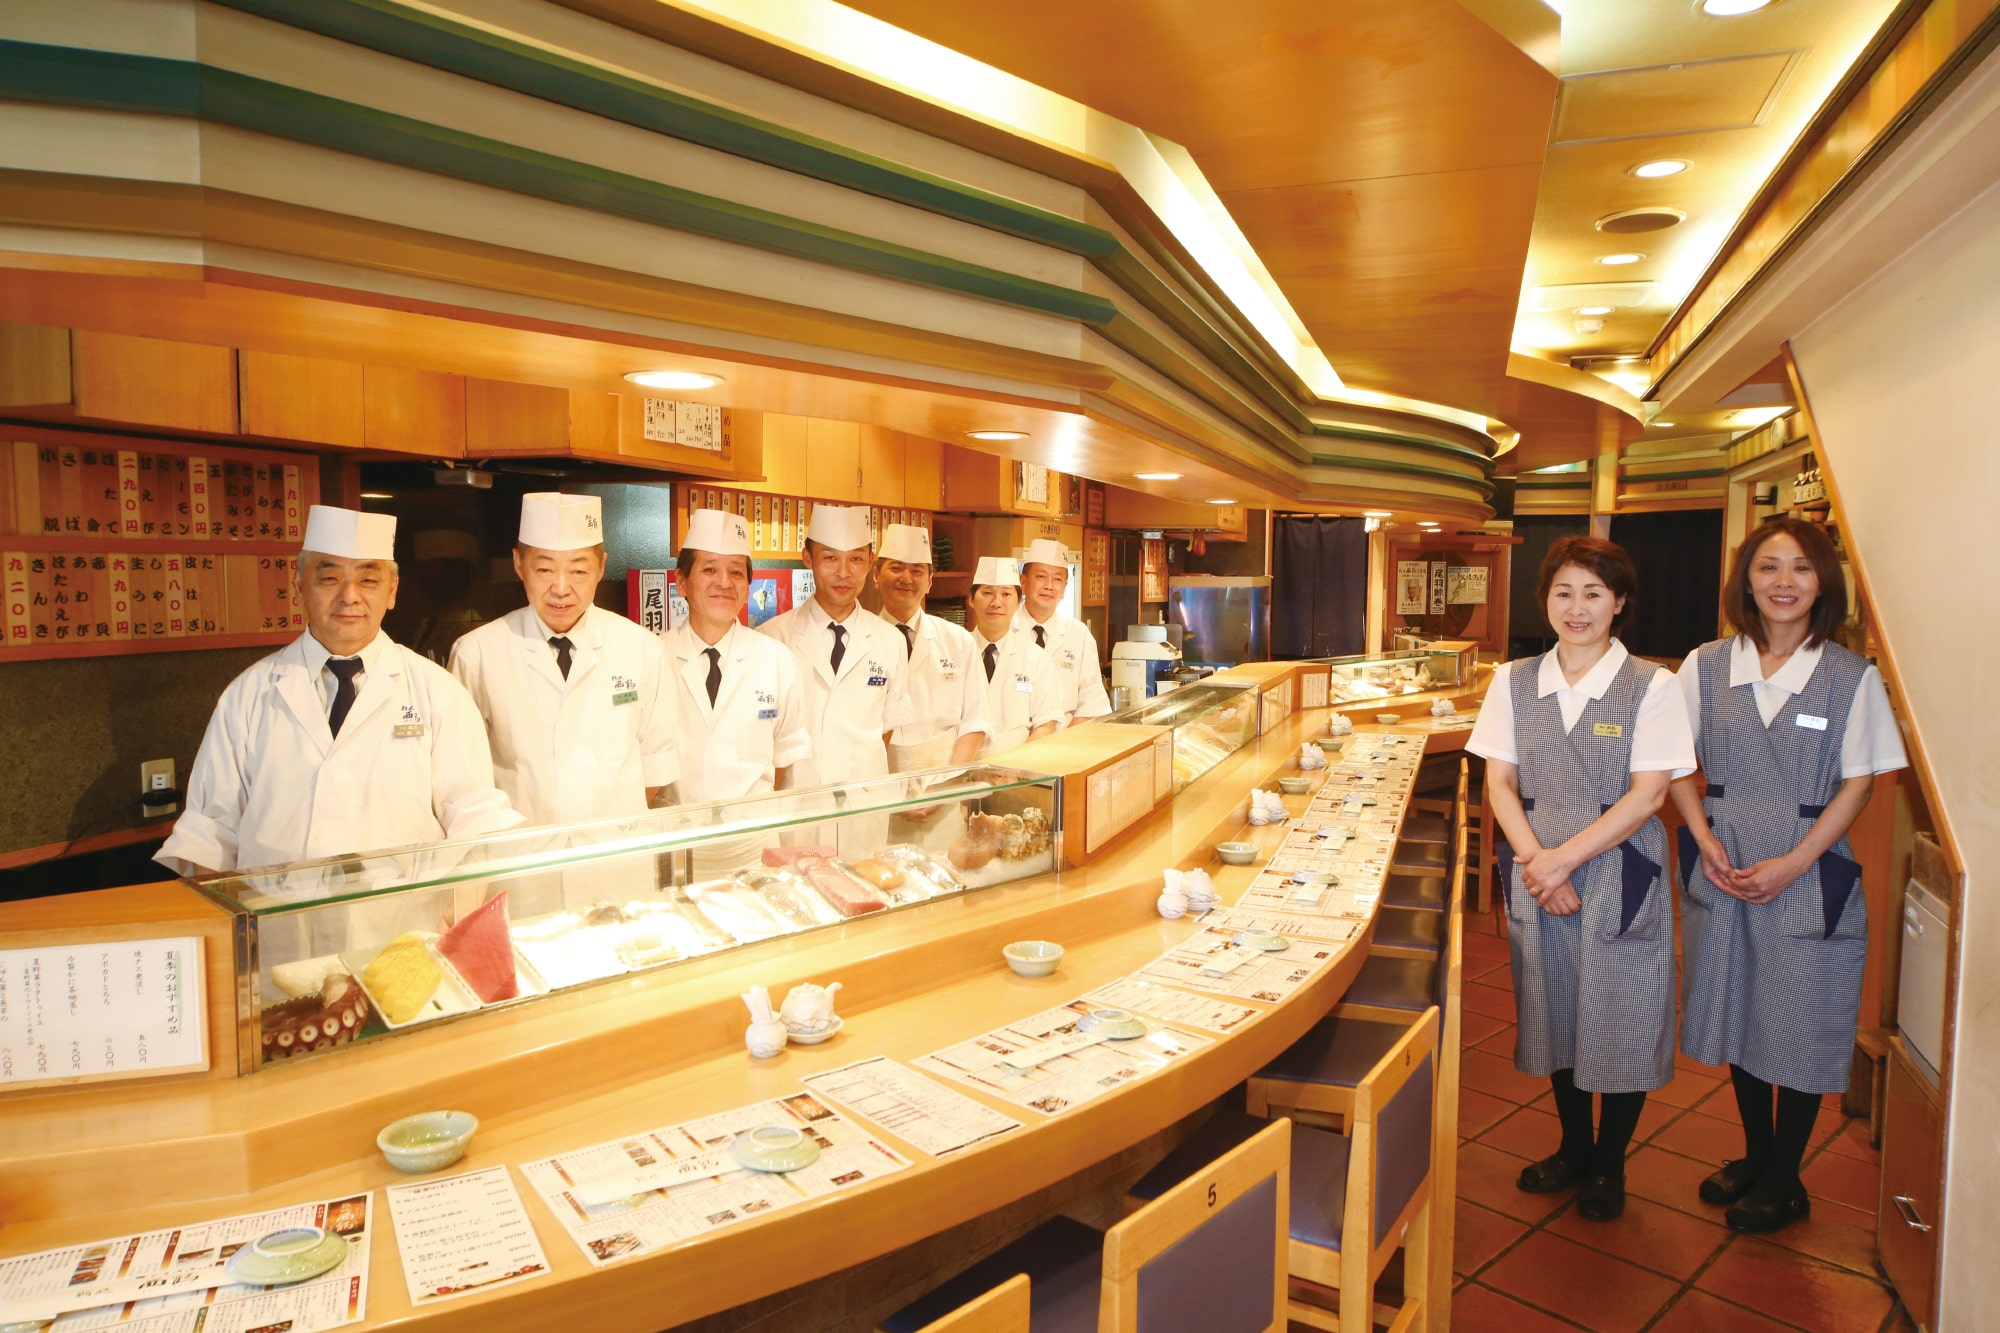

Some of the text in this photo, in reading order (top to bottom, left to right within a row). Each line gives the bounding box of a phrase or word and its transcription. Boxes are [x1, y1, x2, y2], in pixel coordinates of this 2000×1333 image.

[62, 452, 80, 531] さば
[176, 458, 190, 535] サーモン
[209, 464, 223, 536] 玉子
[224, 464, 239, 536] にみそ
[270, 465, 284, 539] 太子
[31, 559, 48, 638] きんき
[73, 556, 89, 637] あわび
[92, 556, 110, 636] 赤貝
[131, 557, 147, 634] 生うに
[185, 556, 200, 631] 皮はぎ
[202, 558, 216, 632] たい
[260, 559, 273, 628] つぶ
[275, 558, 288, 628] 中とろ
[645, 588, 663, 637] 尾羽
[164, 950, 179, 1034] 夏季のおすすめ品
[1208, 1182, 1216, 1208] 5
